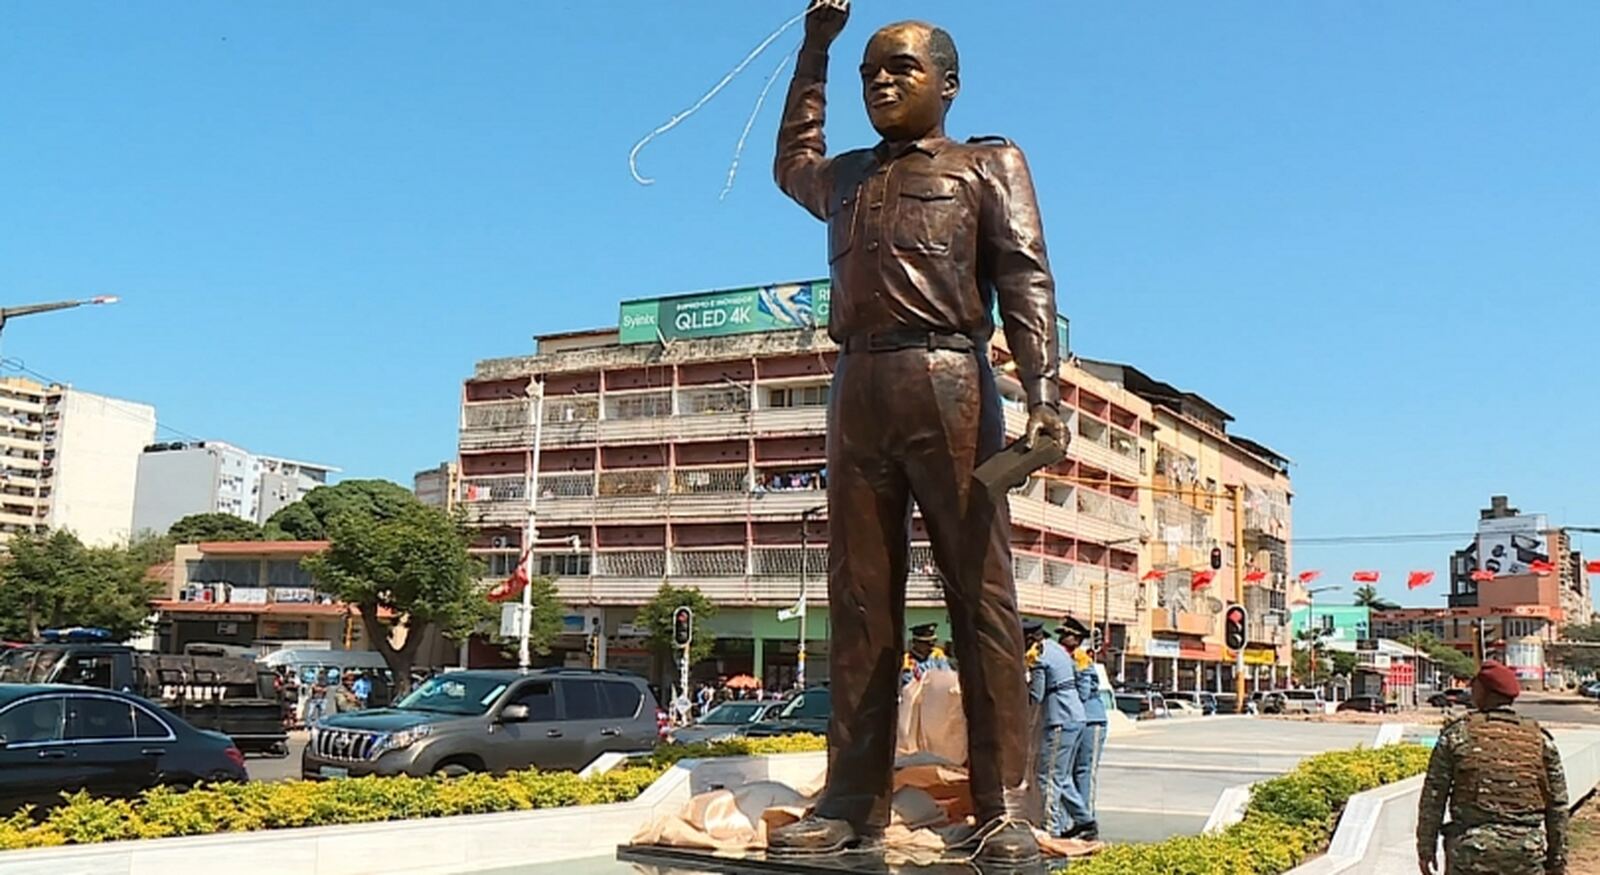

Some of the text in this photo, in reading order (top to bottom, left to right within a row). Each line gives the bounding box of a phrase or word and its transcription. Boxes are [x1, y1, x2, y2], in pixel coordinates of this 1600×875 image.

[623, 313, 656, 329] Syinix
[675, 305, 752, 331] QLED 4K
